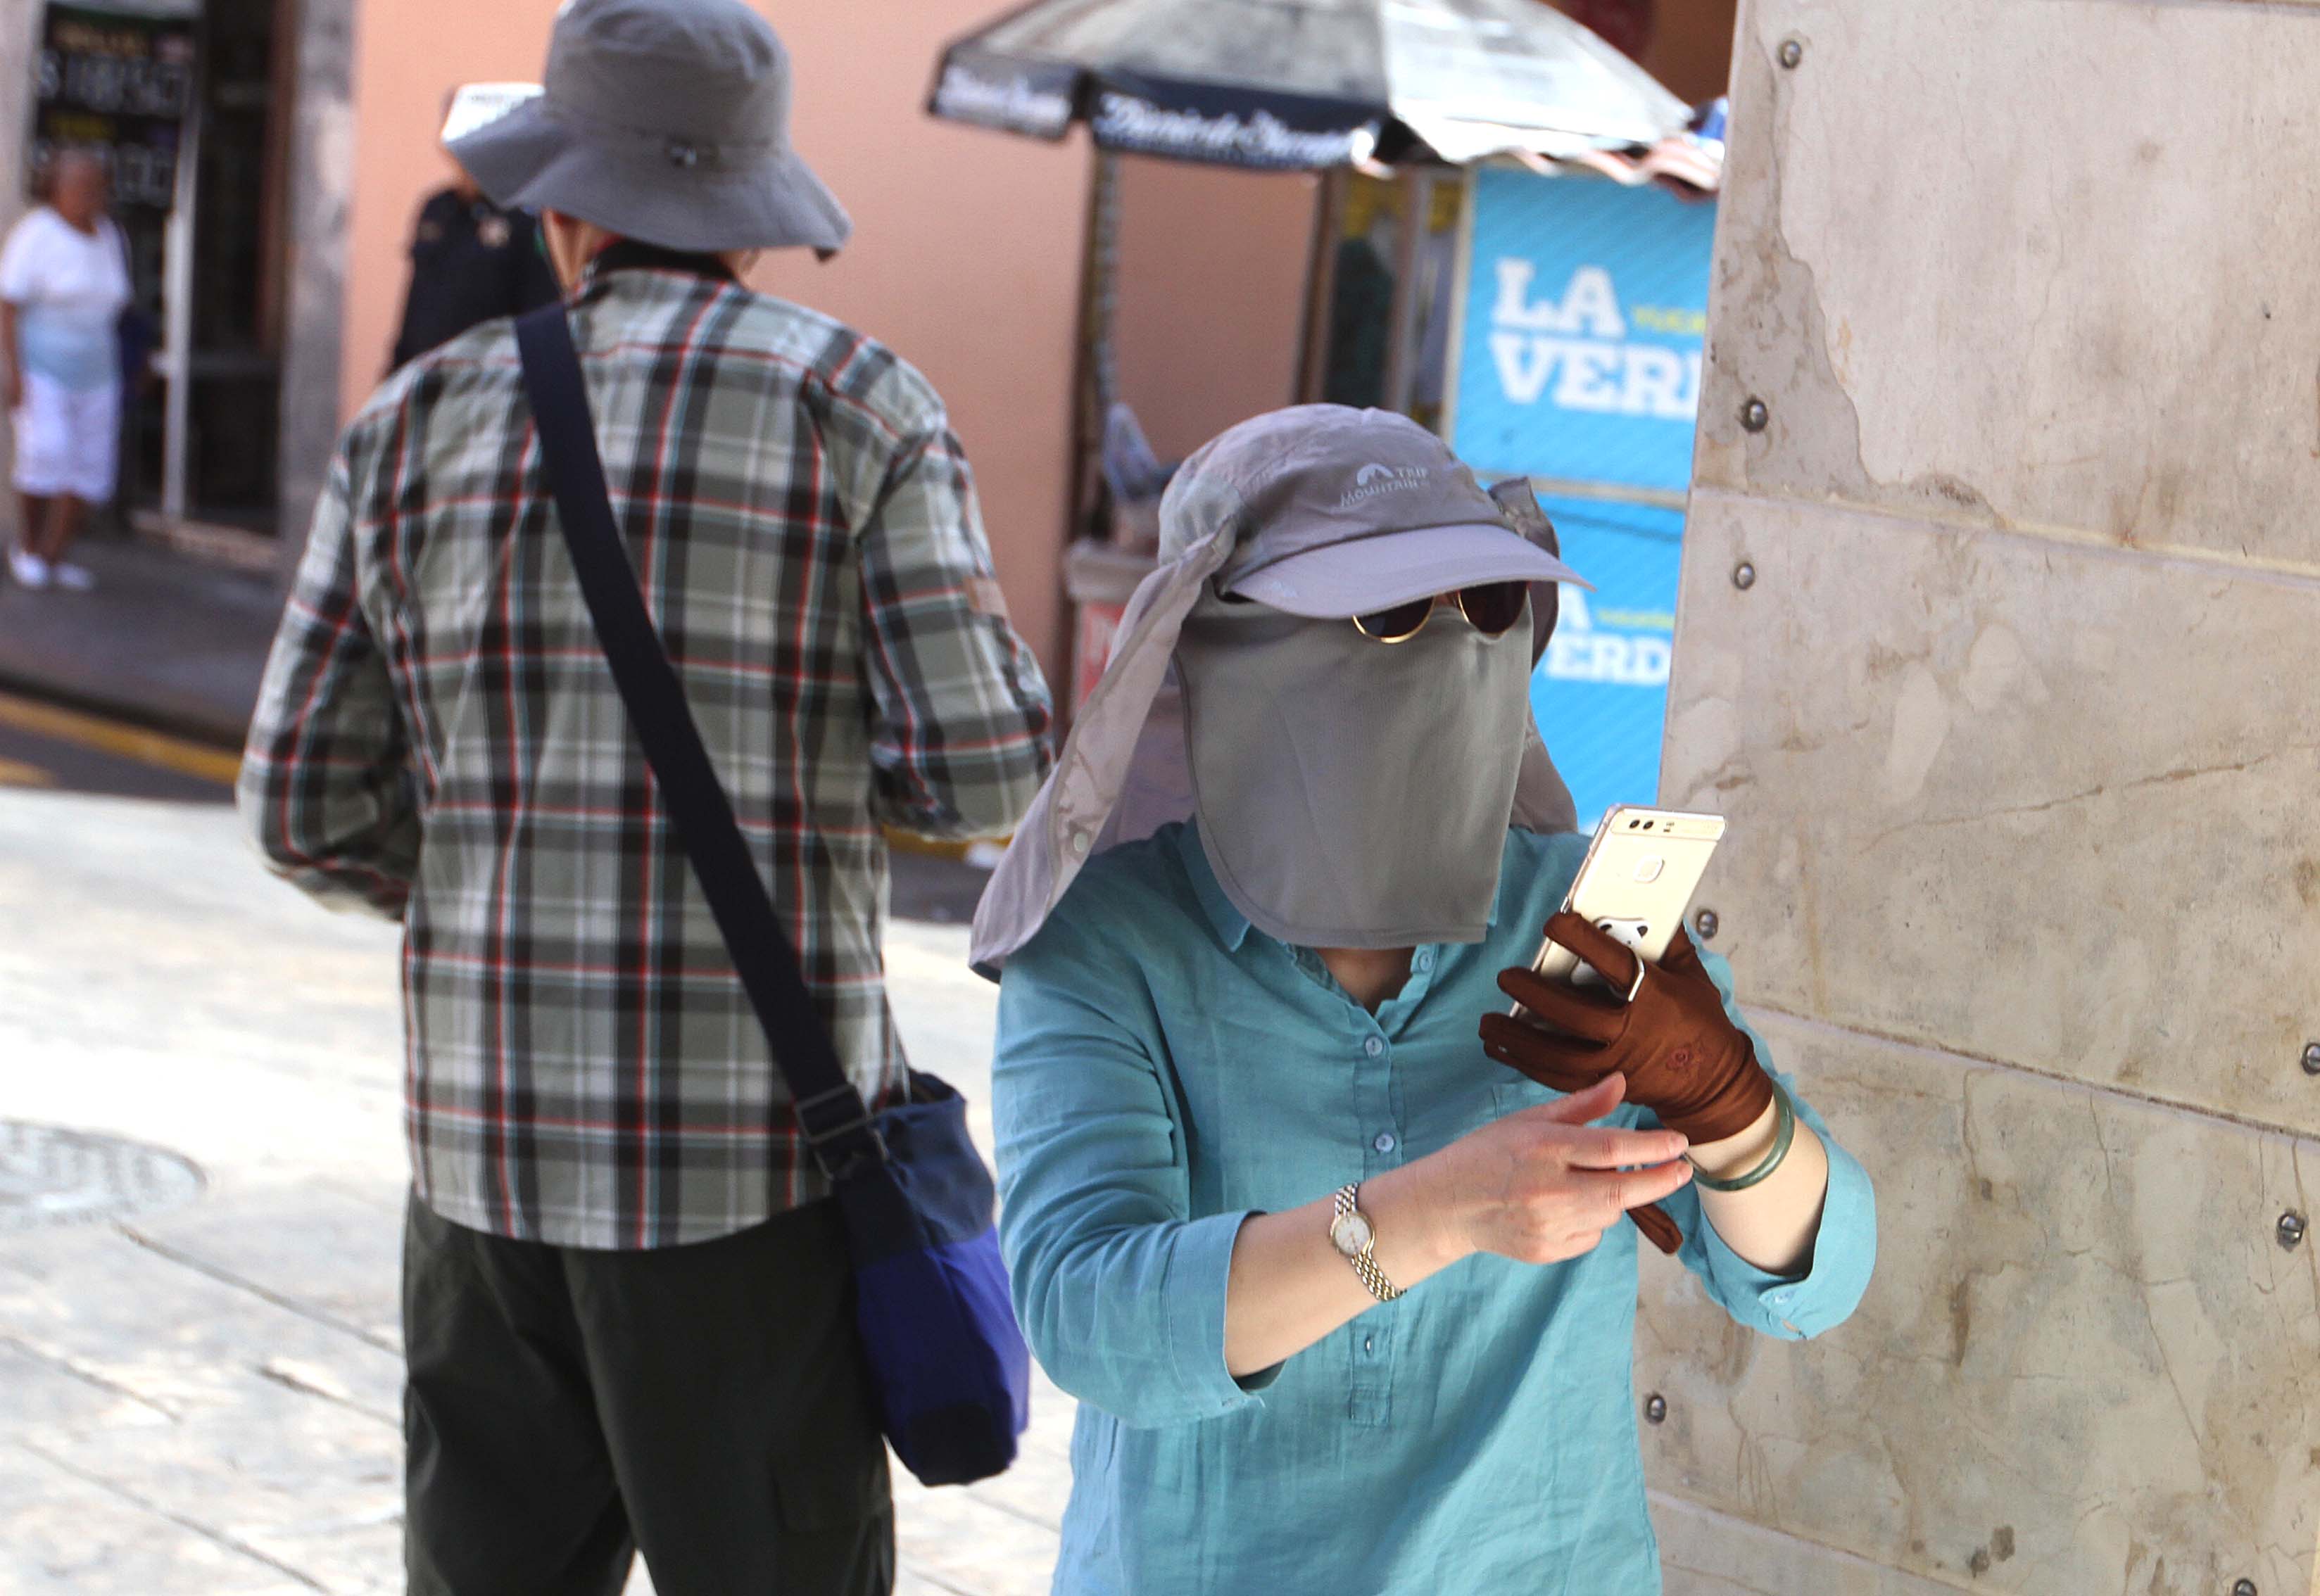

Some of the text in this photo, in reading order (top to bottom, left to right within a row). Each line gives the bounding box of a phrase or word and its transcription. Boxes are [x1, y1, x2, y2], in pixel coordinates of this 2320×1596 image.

[1492, 256, 1626, 338] LA
[1340, 479, 1419, 507] MOUNTAIN
[1396, 467, 1430, 480] TRIP
[1544, 633, 1674, 685] ERD
